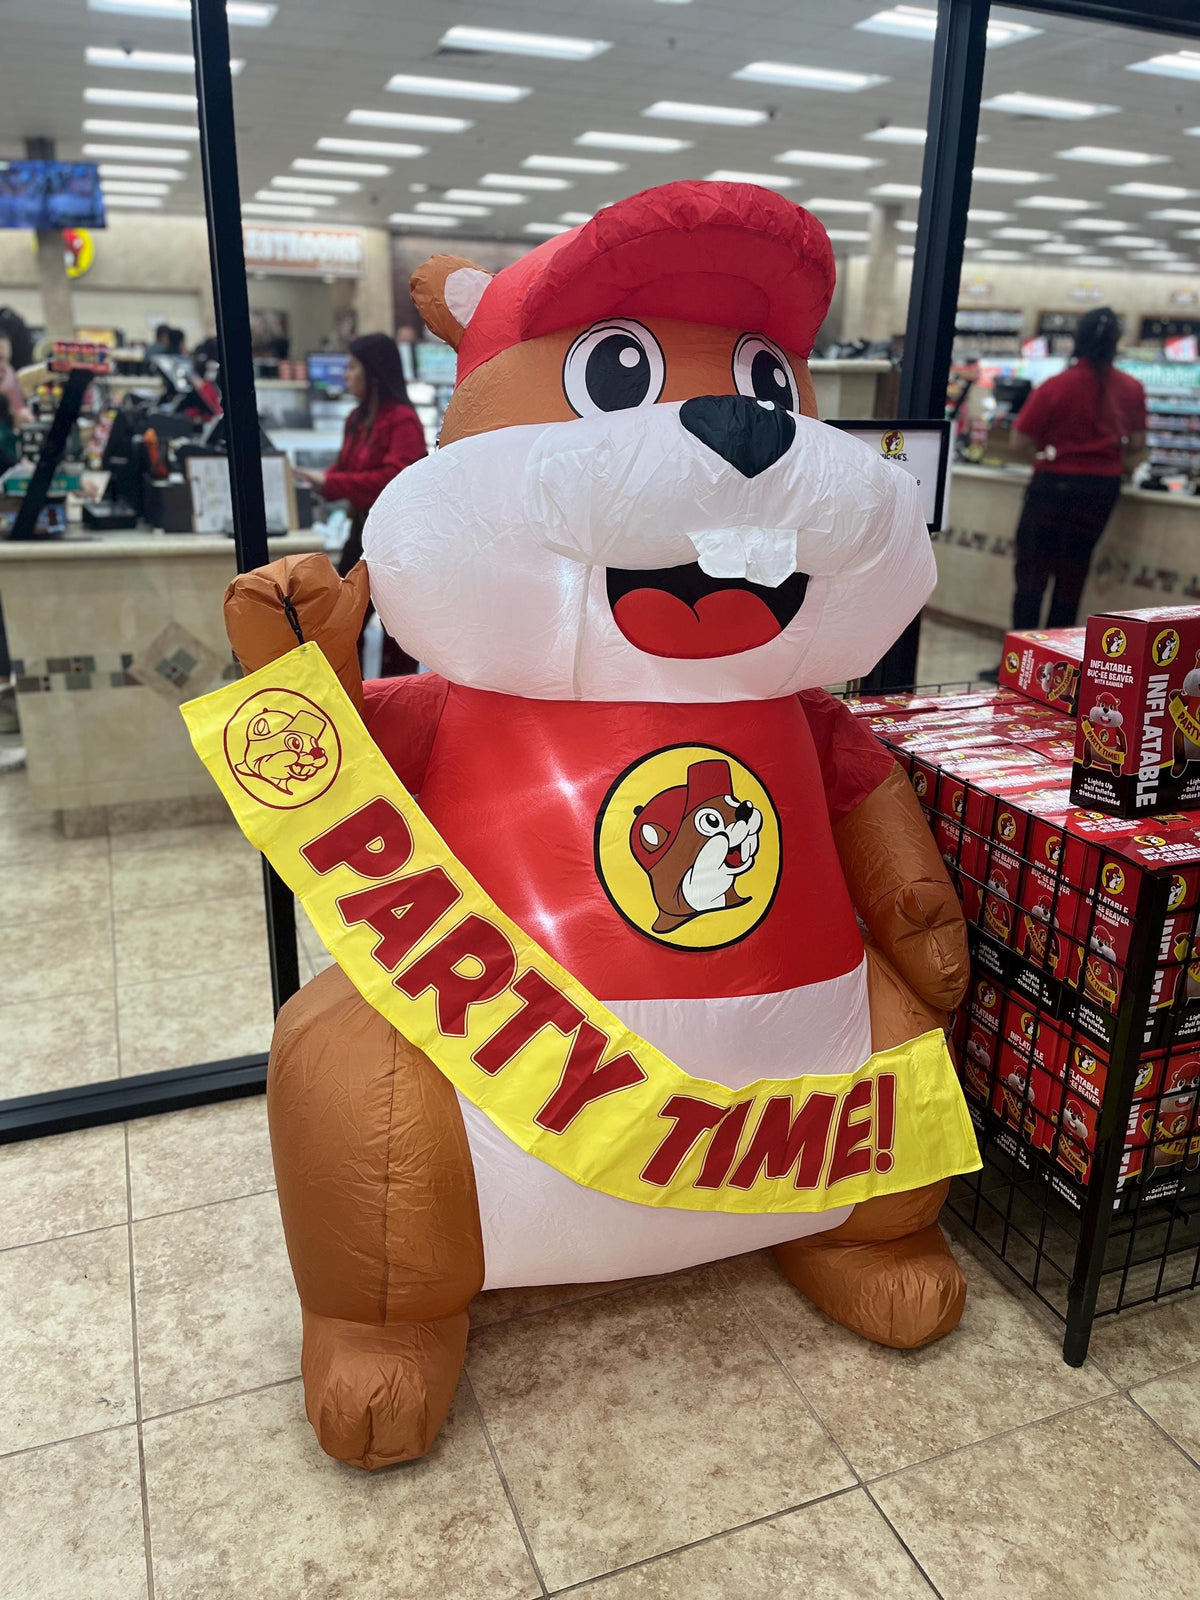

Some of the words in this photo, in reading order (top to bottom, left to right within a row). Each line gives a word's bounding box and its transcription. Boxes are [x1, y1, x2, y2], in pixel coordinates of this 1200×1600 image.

[245, 230, 362, 262] ESTROOMS
[1087, 669, 1108, 680] BUC-EE
[1108, 672, 1134, 684] BEAVER
[1090, 660, 1132, 674] INFLATABLE
[1087, 731, 1101, 750] PARTY
[1101, 747, 1120, 760] TIME!
[1136, 674, 1169, 808] INFLATABLE
[1105, 903, 1130, 927] BEAVER
[300, 795, 648, 1135] PARTY
[639, 1072, 896, 1190] TIME!
[1063, 1062, 1100, 1098] IFLATABLE
